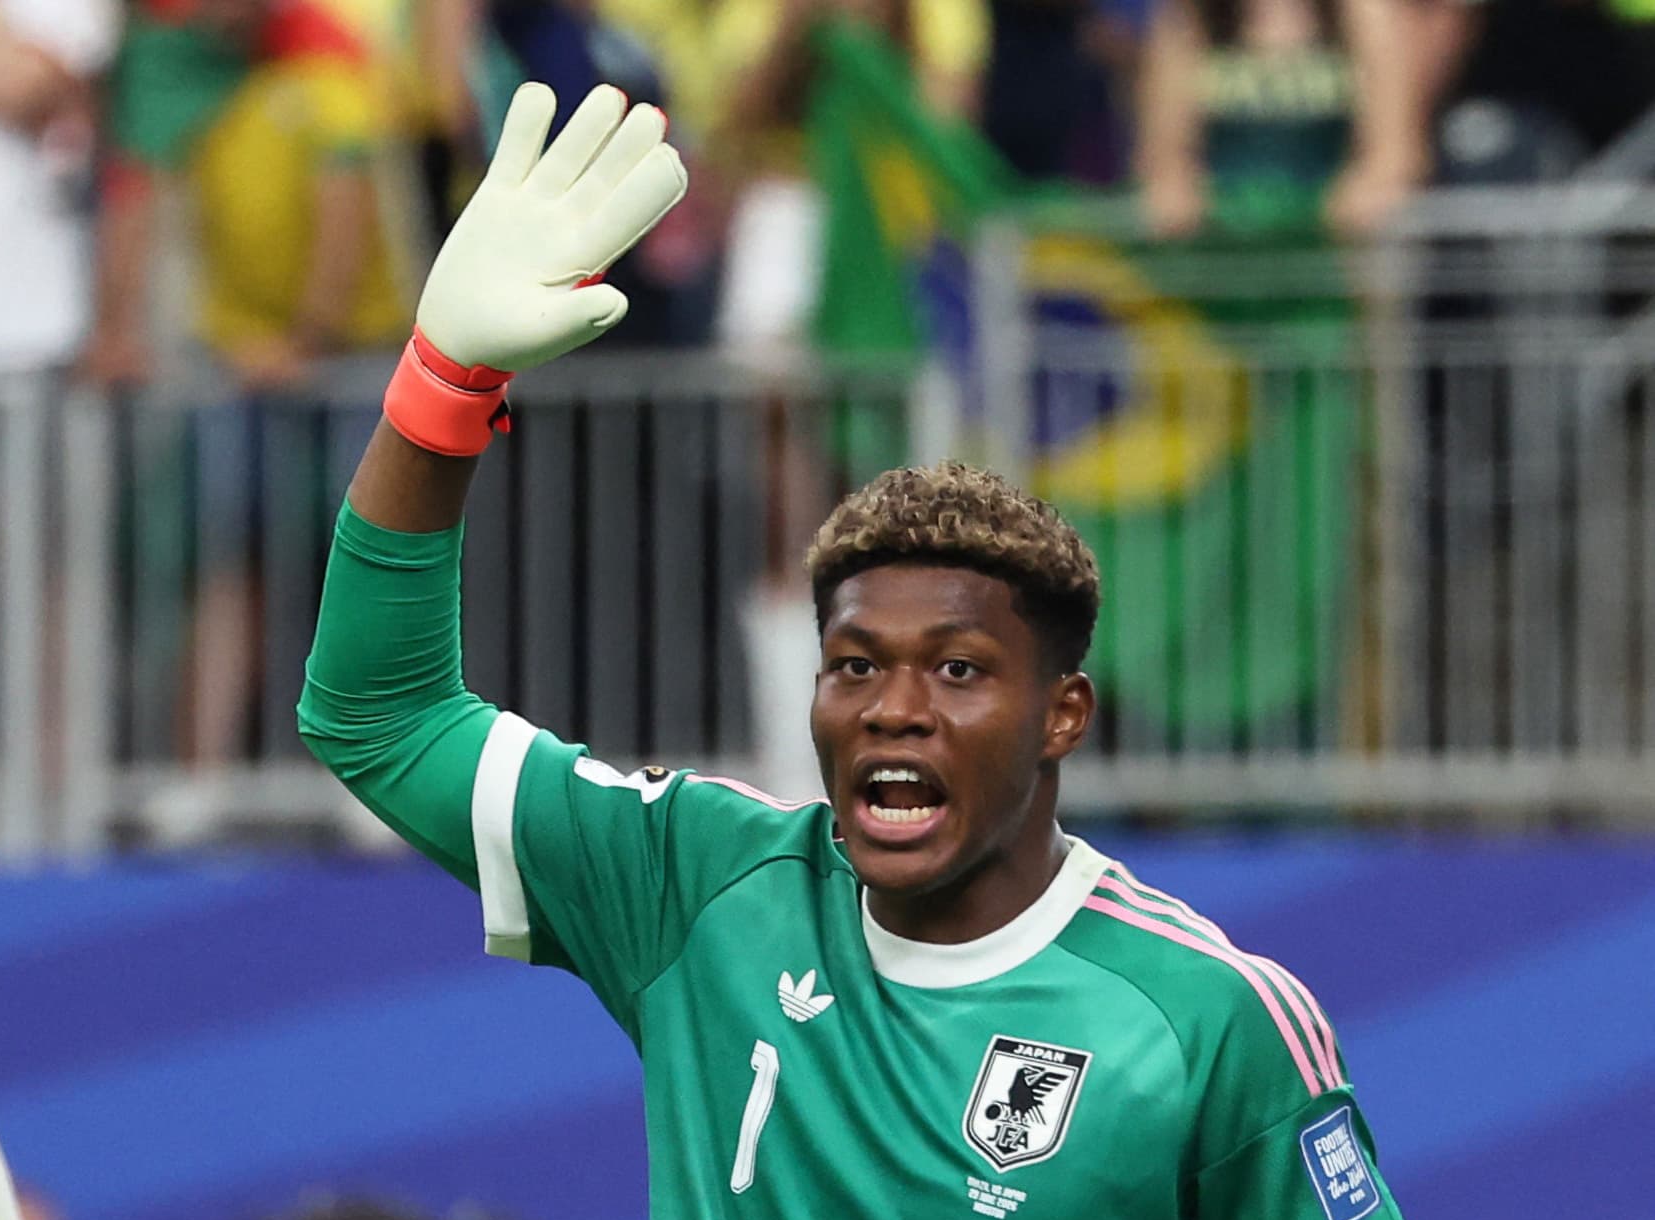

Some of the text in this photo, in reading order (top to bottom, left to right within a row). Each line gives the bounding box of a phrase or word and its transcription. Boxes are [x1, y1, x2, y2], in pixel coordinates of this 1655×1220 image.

[1013, 1043, 1066, 1063] JAPAN
[730, 1038, 781, 1194] 1
[987, 1125, 1029, 1150] JFA
